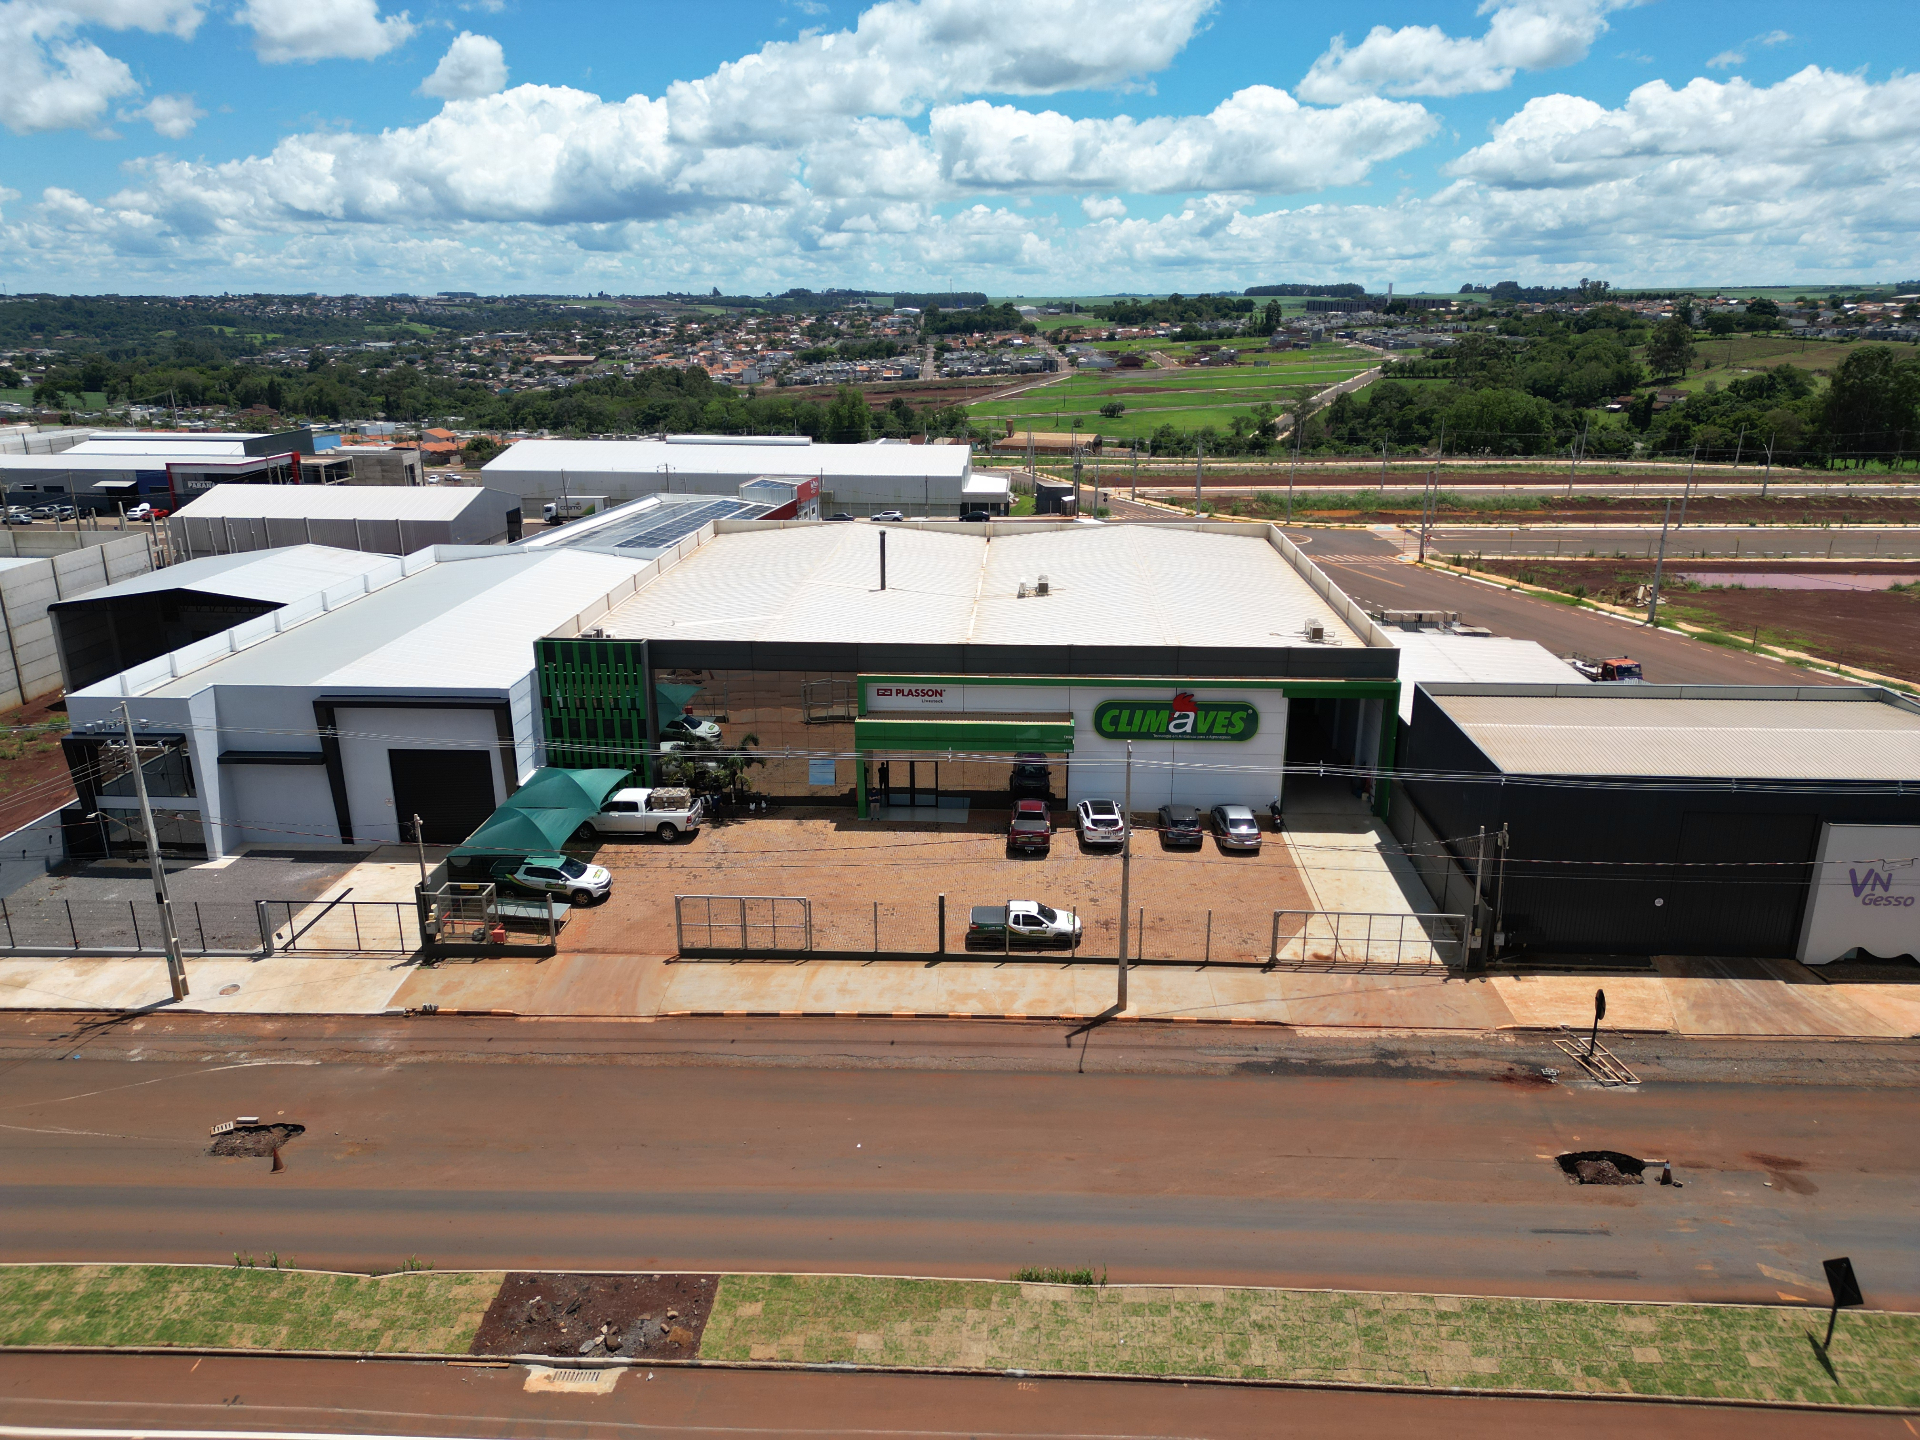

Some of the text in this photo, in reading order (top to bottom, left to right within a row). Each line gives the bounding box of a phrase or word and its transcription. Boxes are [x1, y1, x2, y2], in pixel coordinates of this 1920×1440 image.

[896, 689, 943, 697] PLASSON
[1849, 868, 1892, 897] VN
[1862, 893, 1915, 907] Gesso
